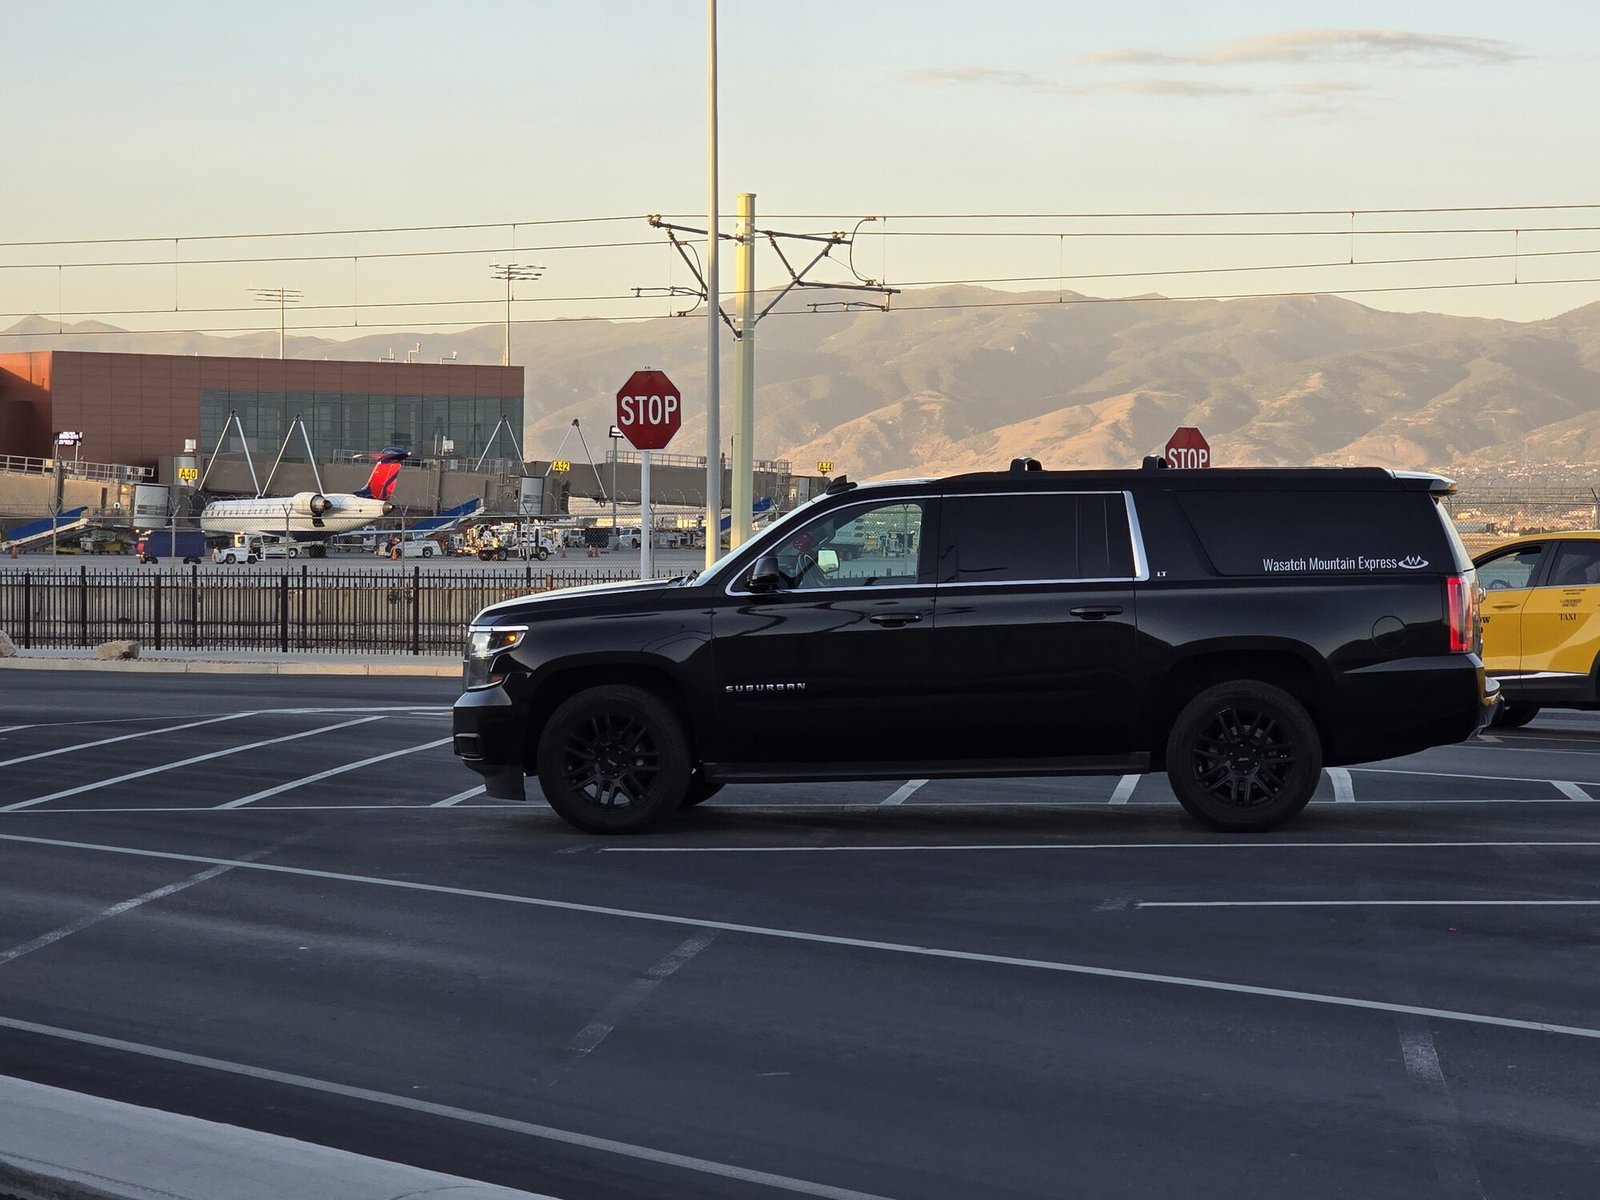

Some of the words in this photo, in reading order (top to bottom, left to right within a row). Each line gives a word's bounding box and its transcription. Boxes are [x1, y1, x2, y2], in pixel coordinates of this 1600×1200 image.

[620, 395, 678, 426] STOP
[1168, 448, 1208, 469] STOP
[554, 461, 569, 471] A42
[180, 469, 197, 479] A40
[1262, 558, 1307, 572] Wasatch
[1309, 557, 1356, 571] Mountain
[1358, 556, 1398, 571] Express
[1559, 612, 1577, 621] TAXI
[725, 682, 806, 693] SUBURBAN
